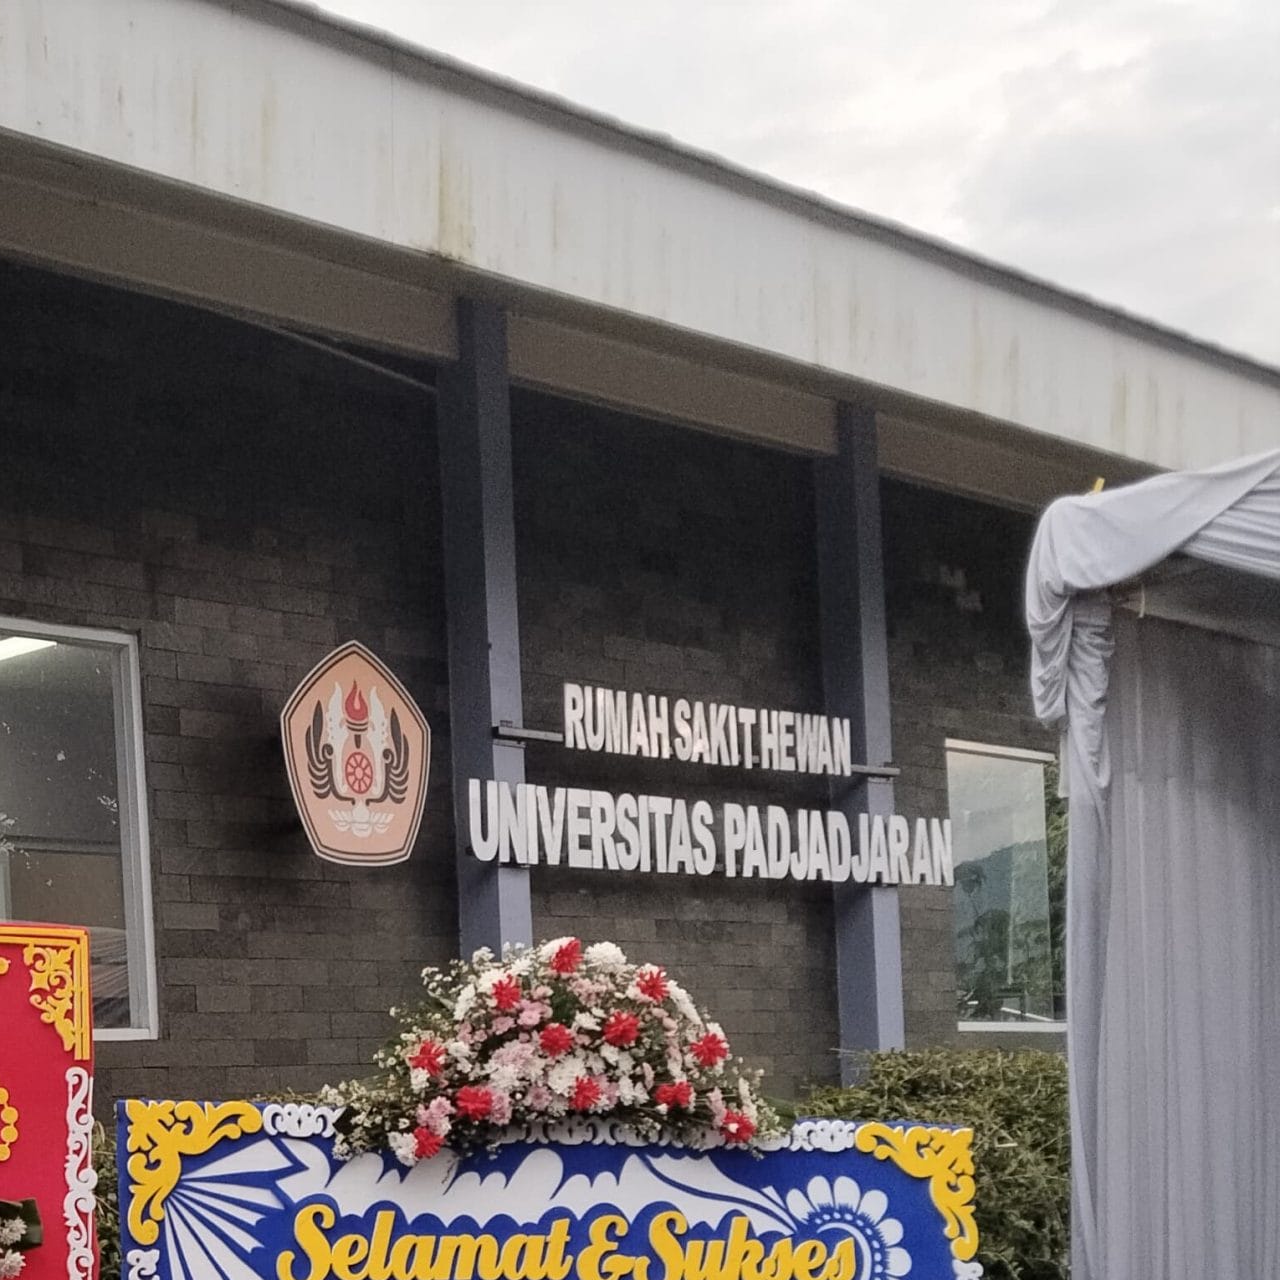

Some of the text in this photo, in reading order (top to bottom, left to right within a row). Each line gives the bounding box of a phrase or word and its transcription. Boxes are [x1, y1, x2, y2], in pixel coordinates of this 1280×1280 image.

[563, 683, 852, 777] RUMAH SAKIT HEWAN
[468, 778, 954, 886] UNIVERSITAS PADJADJARAN
